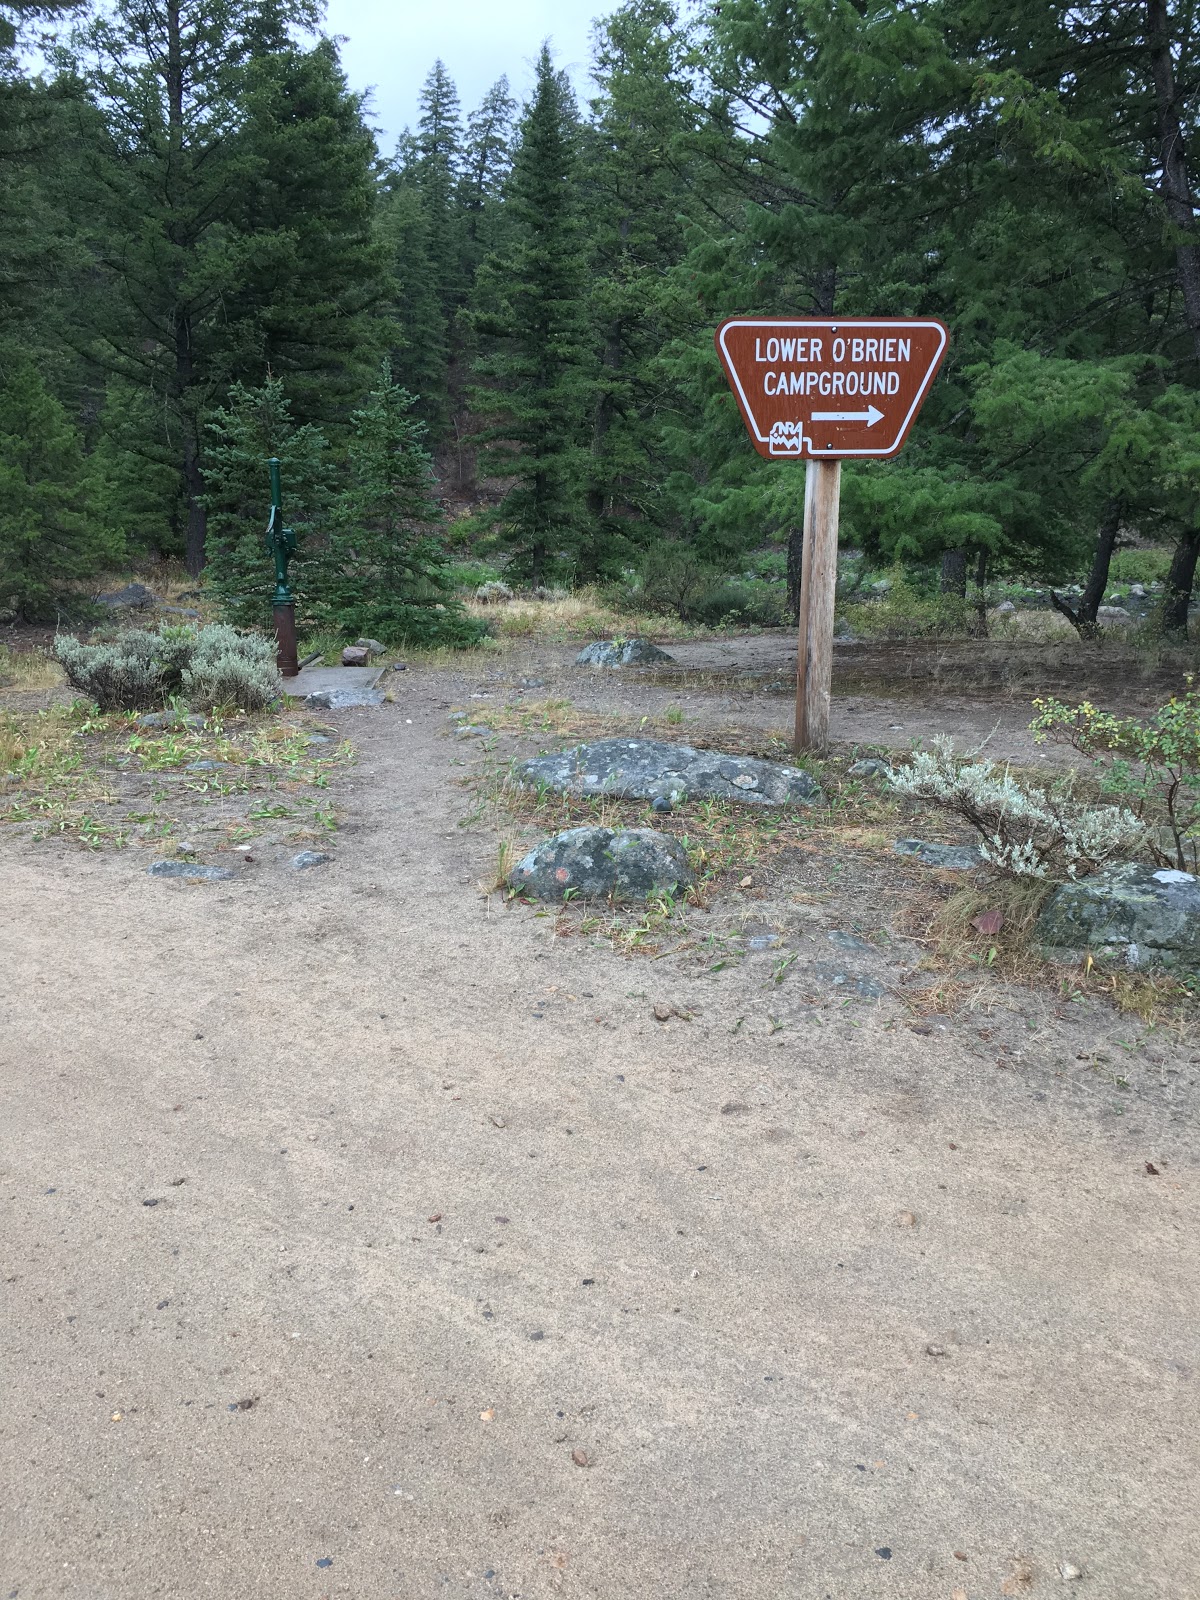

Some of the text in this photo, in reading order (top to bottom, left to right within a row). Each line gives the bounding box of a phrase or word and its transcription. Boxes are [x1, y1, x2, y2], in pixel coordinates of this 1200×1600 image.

[755, 338, 911, 362] LOWER O'BRIEN
[764, 371, 900, 396] CAMPGROUND
